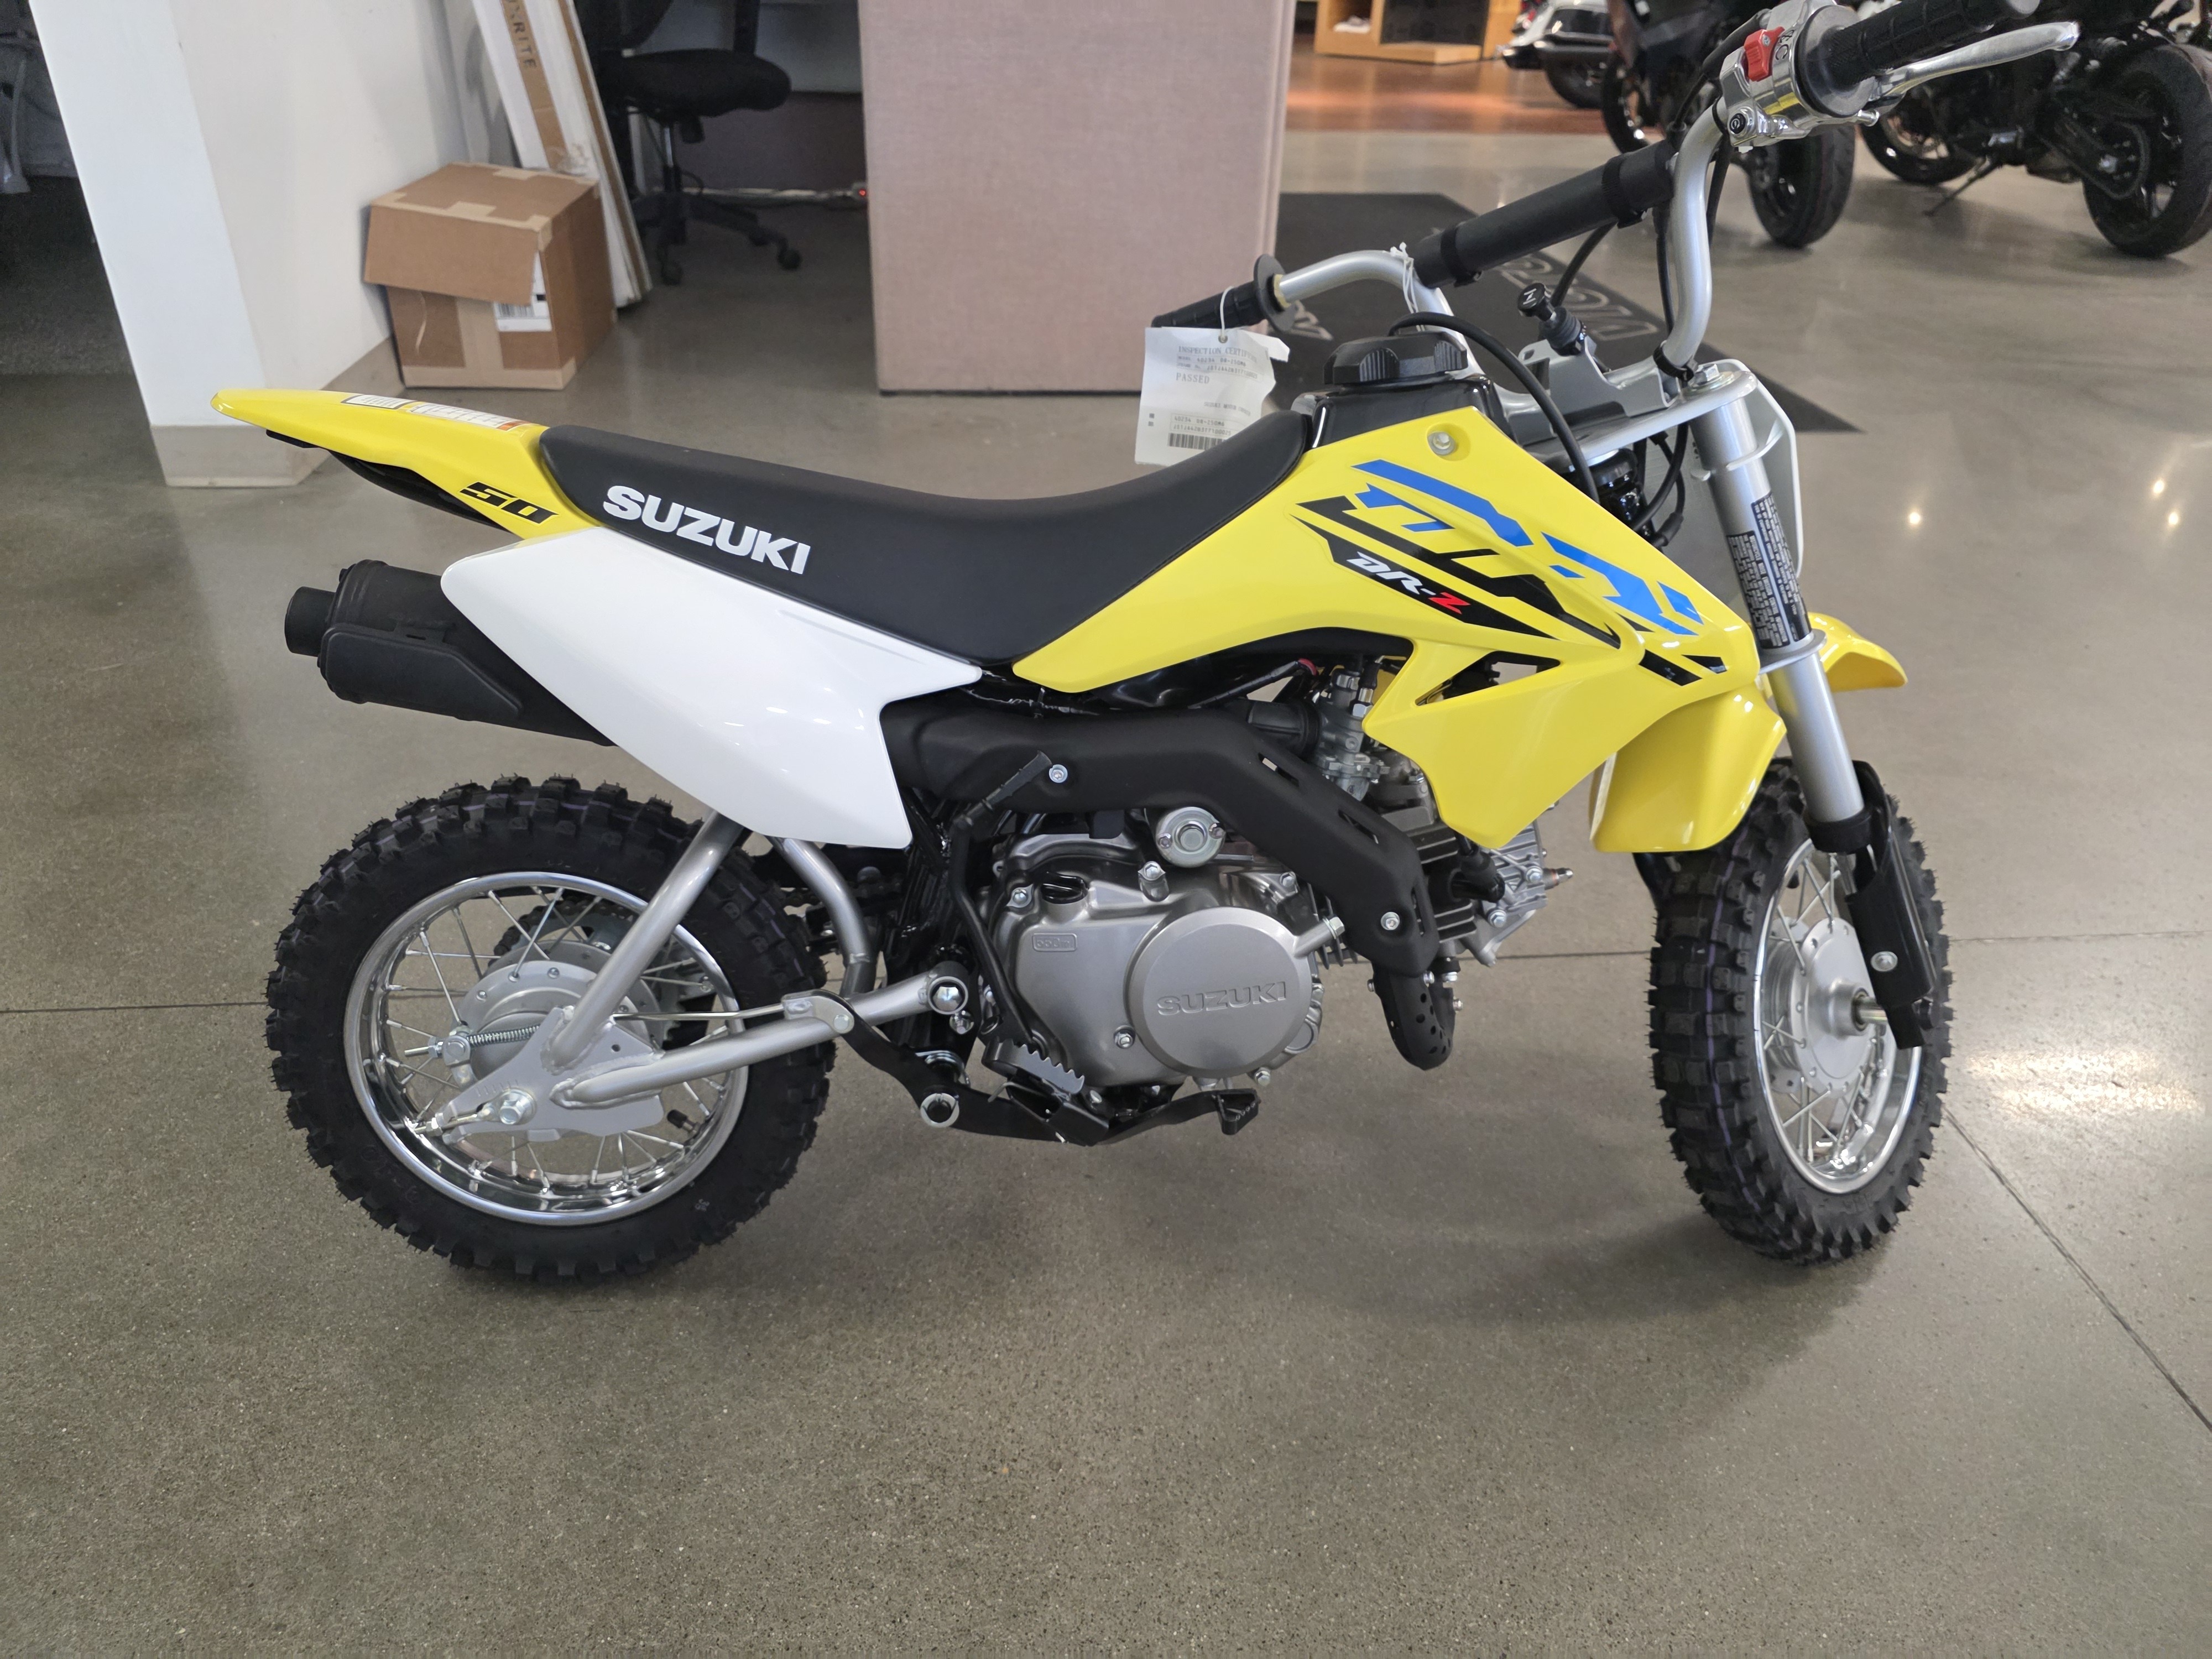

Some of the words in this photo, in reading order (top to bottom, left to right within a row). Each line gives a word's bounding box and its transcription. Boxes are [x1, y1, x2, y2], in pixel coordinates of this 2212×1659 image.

[504, 0, 538, 68] XRITE
[1178, 346, 1221, 354] INSPECTION
[1176, 372, 1210, 384] PASSED
[460, 482, 559, 524] 50
[603, 485, 811, 575] SUZUKI
[1347, 551, 1471, 615] DR-Z
[1157, 981, 1286, 1015] SUZUKI
